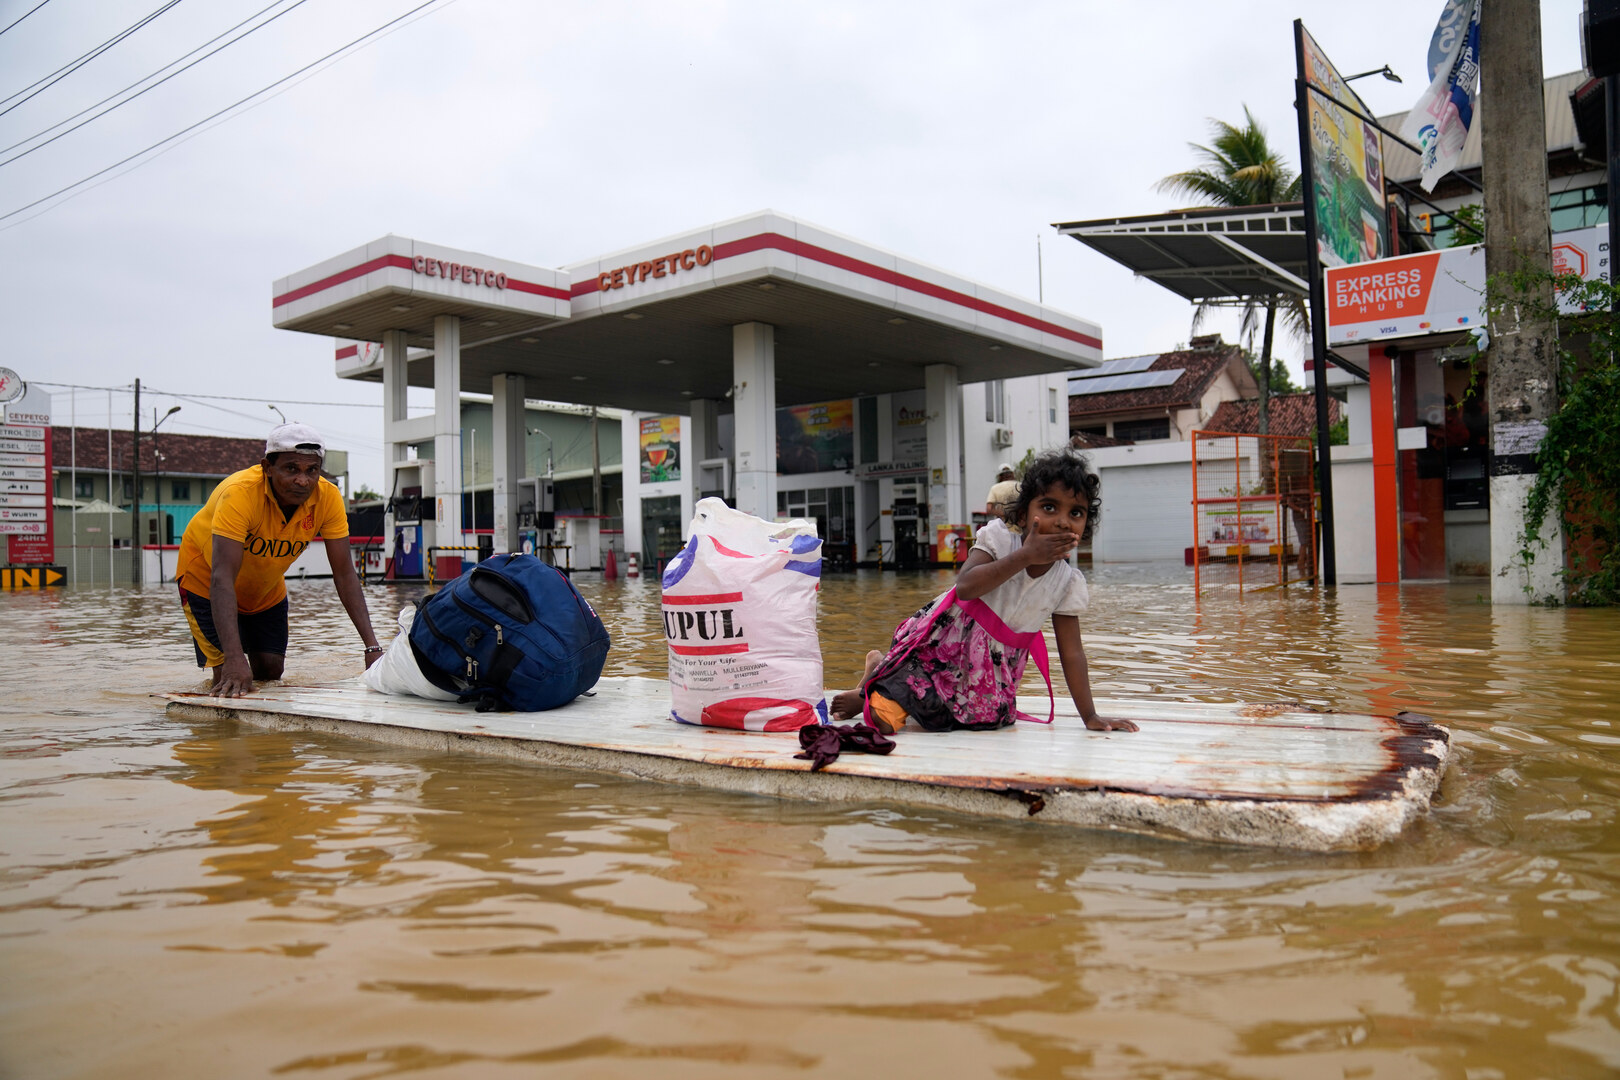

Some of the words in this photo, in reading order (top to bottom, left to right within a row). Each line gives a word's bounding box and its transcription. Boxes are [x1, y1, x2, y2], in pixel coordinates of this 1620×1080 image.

[413, 255, 508, 289] CEYPETCO
[598, 245, 713, 291] CEYPETCO
[1336, 268, 1421, 293] EXPRESS
[1336, 284, 1421, 308] BANKING
[1380, 326, 1398, 334] VISA
[9, 412, 50, 421] CEYPETCO
[868, 463, 894, 473] LANKA
[896, 460, 926, 471] FILLING
[2, 568, 40, 586] IN
[662, 609, 744, 641] UPUL
[684, 658, 697, 666] For
[698, 658, 717, 666] Your
